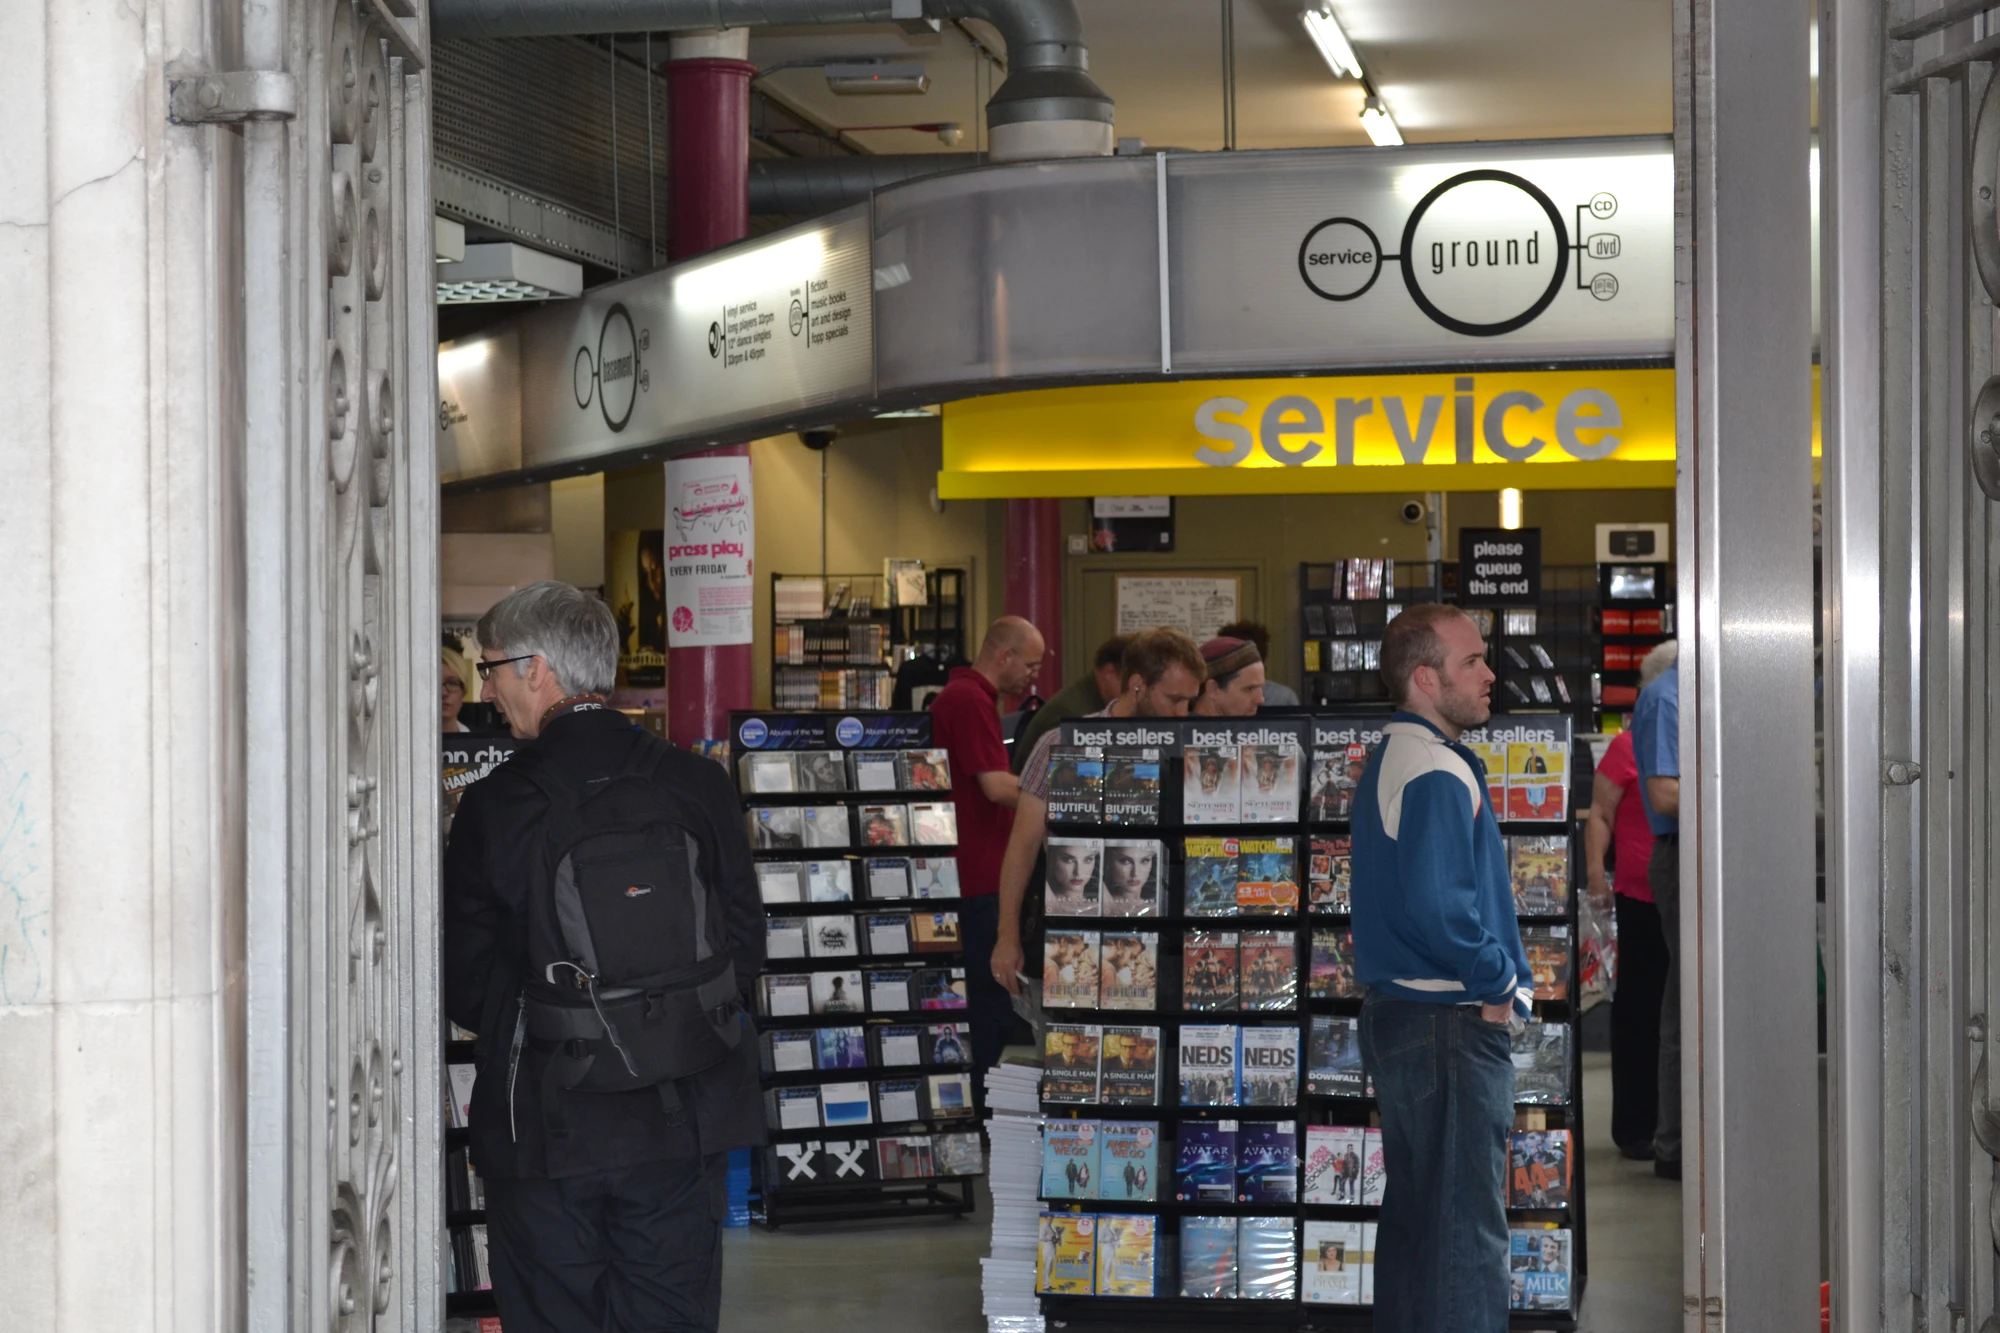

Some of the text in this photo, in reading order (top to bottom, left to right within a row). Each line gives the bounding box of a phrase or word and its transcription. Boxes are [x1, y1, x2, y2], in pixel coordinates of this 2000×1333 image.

[1594, 201, 1613, 212] CD
[1431, 231, 1540, 275] ground
[1596, 238, 1616, 255] dvd
[1308, 248, 1373, 267] service
[810, 281, 829, 294] fiction
[739, 300, 758, 315] service
[810, 291, 847, 310] music books
[739, 317, 758, 331] players
[811, 307, 852, 328] art and design
[736, 335, 752, 347] dance
[752, 329, 773, 344] singles
[825, 325, 850, 342] specials
[603, 350, 633, 384] basement
[1193, 377, 1623, 468] service
[668, 539, 744, 561] press play
[1473, 540, 1524, 559] please
[669, 562, 728, 577] EVERY FRIDAY
[1475, 562, 1523, 578] queue
[1469, 578, 1529, 595] this end
[769, 729, 793, 737] Albums
[800, 728, 811, 736] the
[811, 728, 825, 736] Year
[865, 728, 888, 736] Albums
[895, 727, 906, 735] the
[905, 727, 920, 735] Year
[1073, 728, 1175, 746] best sellers
[1192, 728, 1298, 745] best sellers
[1315, 727, 1357, 744] best
[1492, 725, 1555, 742] sellers
[1048, 802, 1100, 813] BIUTIFUL
[1105, 804, 1156, 815] BIUTIFUL
[1064, 984, 1092, 996] VALENTINE
[1121, 987, 1149, 998] VALENTINE
[1181, 1046, 1233, 1065] NEDS
[1244, 1047, 1296, 1067] NEDS
[1079, 1070, 1097, 1078] MAN
[1308, 1071, 1361, 1083] DOWNFALL
[1055, 1147, 1088, 1156] WE GO
[1113, 1149, 1146, 1159] WE GO
[1183, 1146, 1228, 1155] AVATAR
[1244, 1147, 1290, 1156] AVATAR
[1514, 1162, 1549, 1197] 44
[1527, 1277, 1567, 1292] MILK
